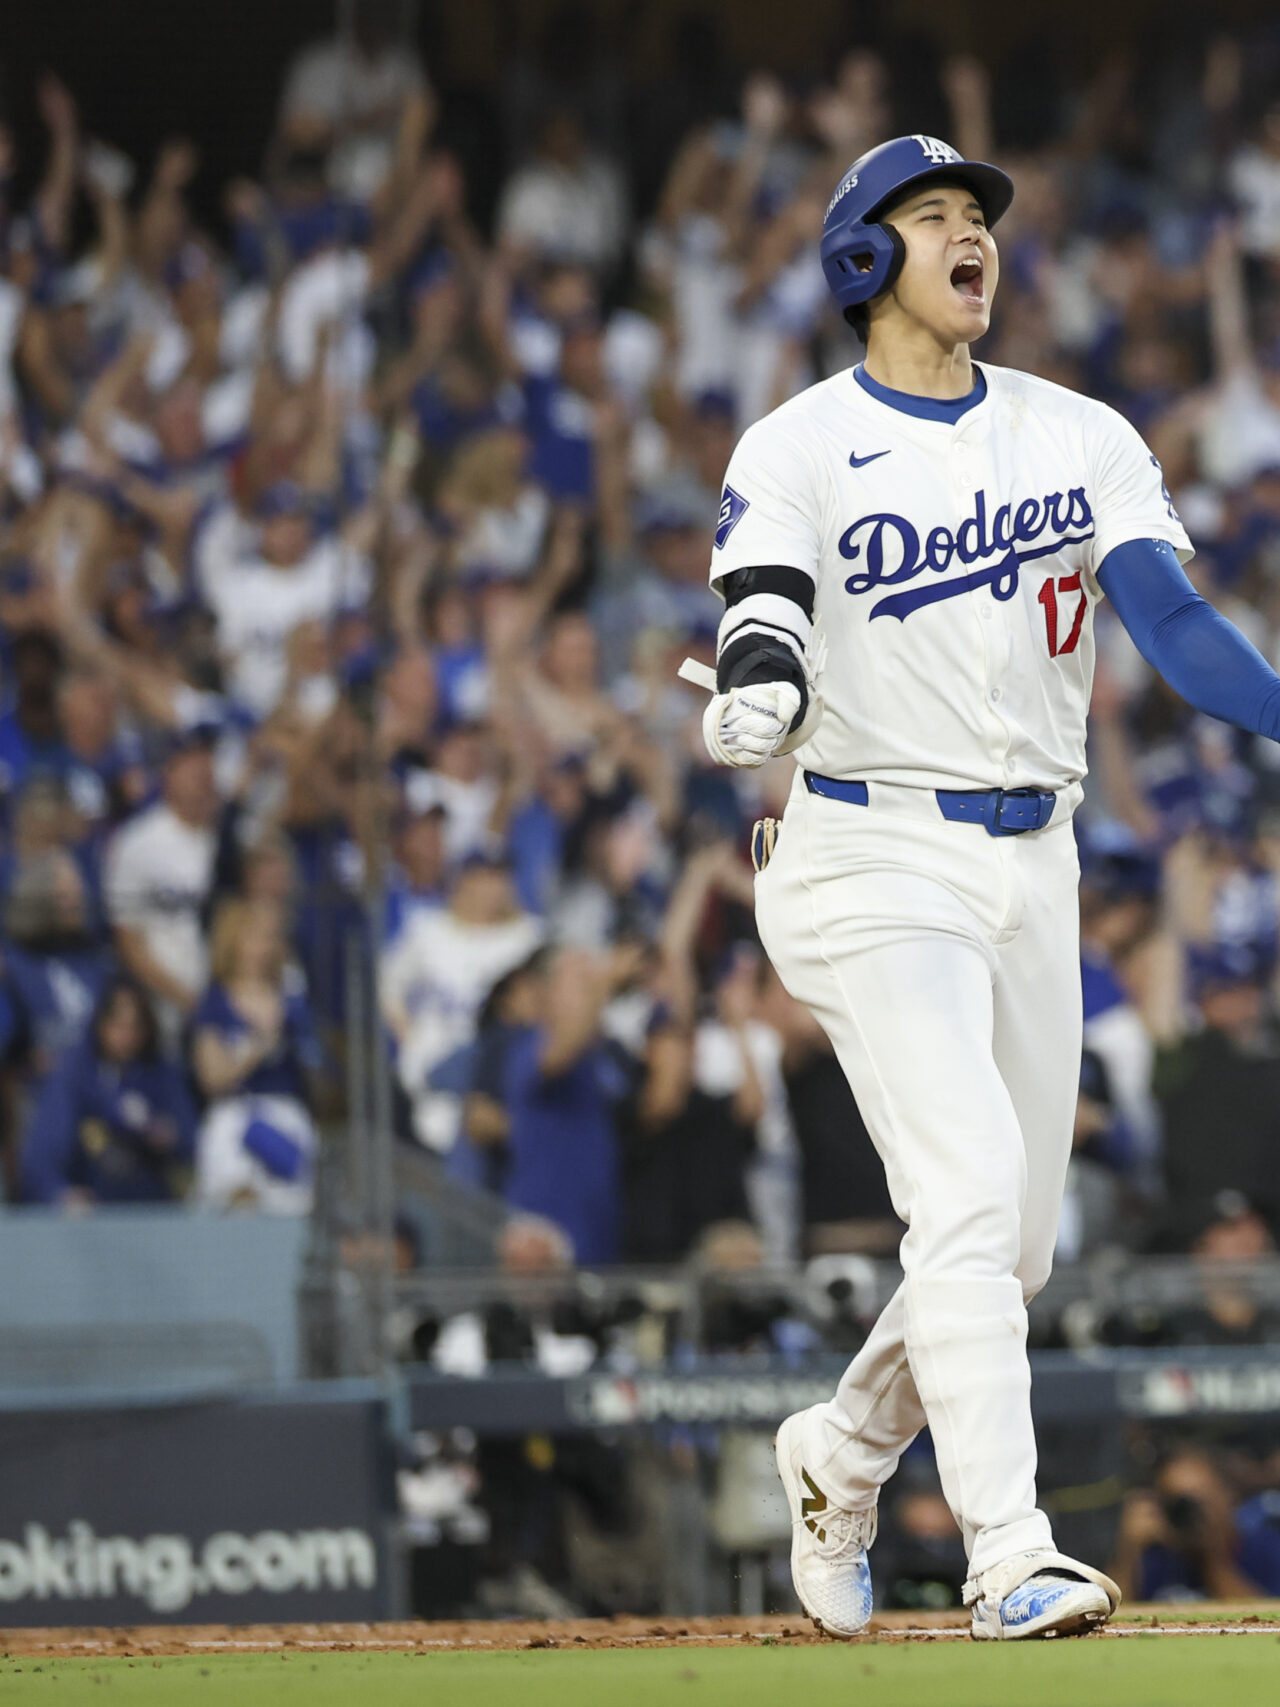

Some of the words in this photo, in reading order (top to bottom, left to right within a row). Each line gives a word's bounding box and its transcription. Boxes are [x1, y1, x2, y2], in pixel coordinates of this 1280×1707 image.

[911, 134, 957, 164] LA
[838, 487, 1094, 601] Dodgers
[1037, 570, 1088, 658] 17
[737, 697, 751, 708] new
